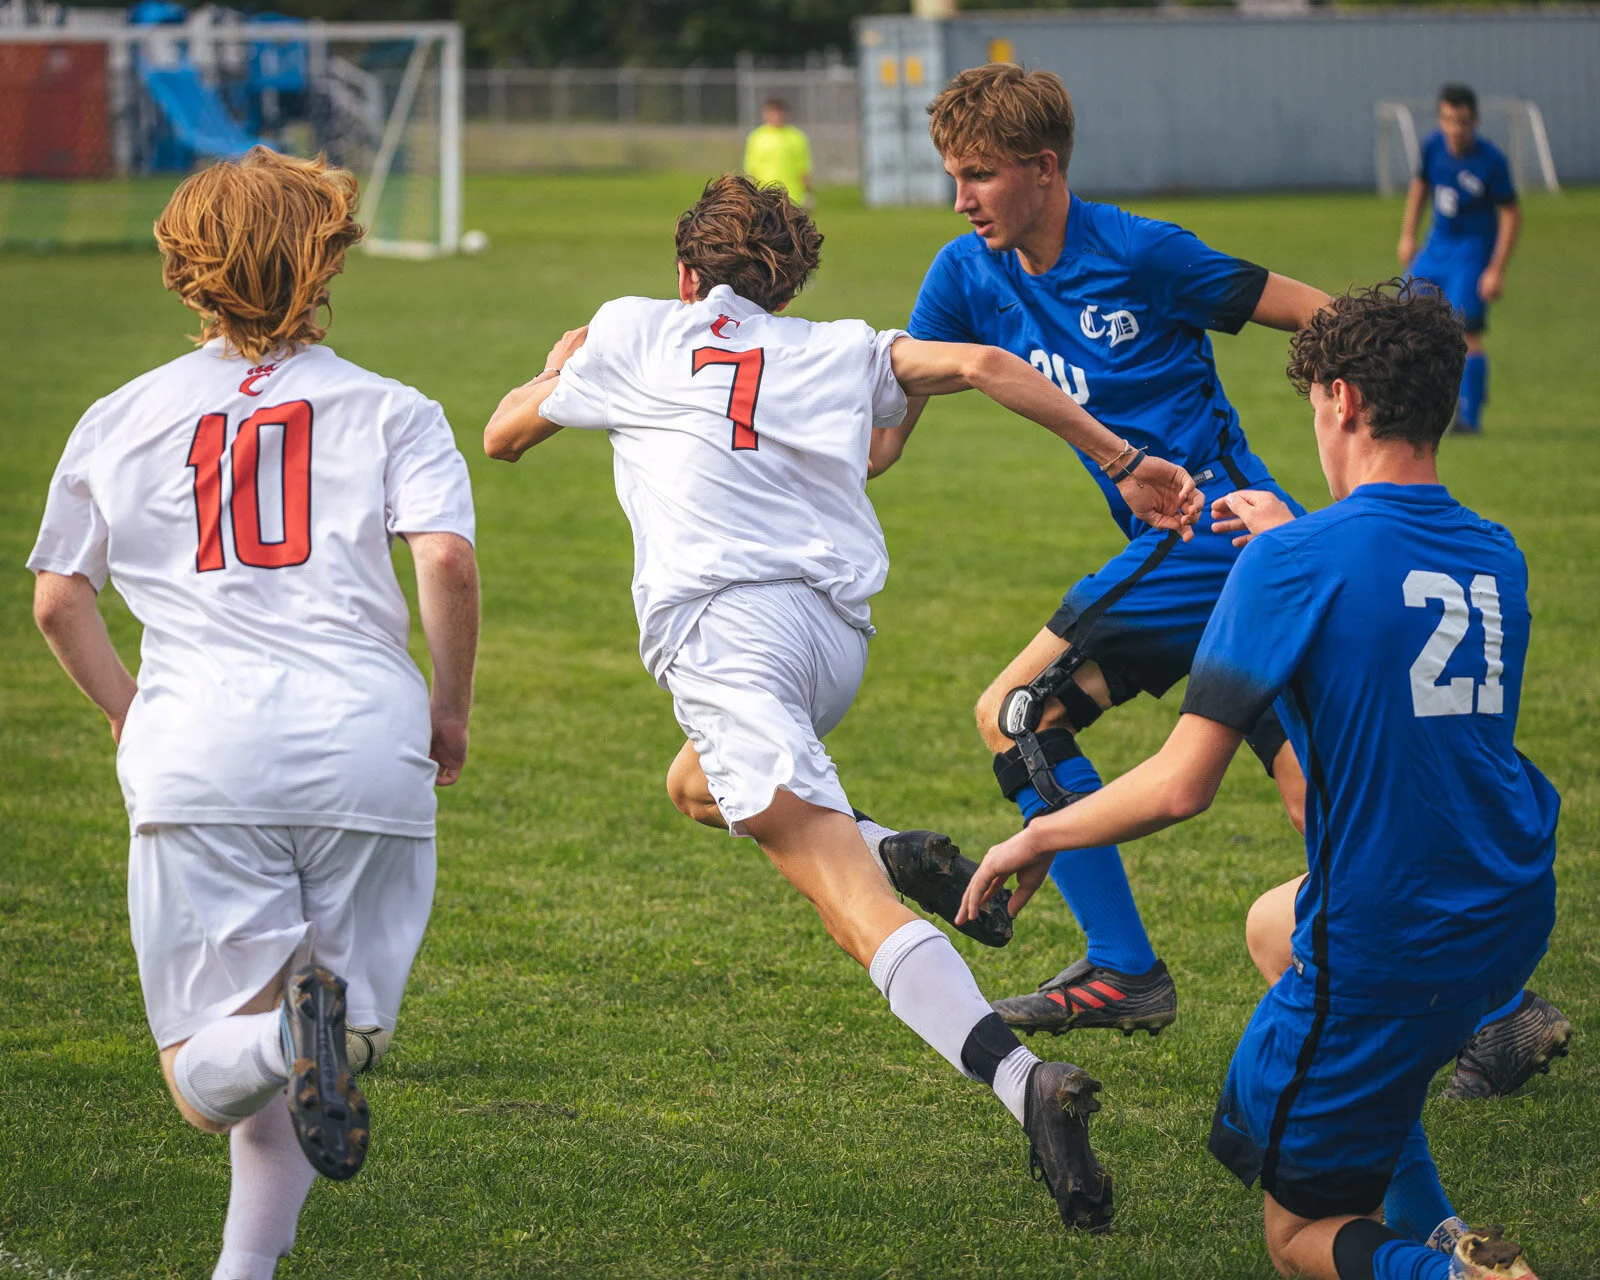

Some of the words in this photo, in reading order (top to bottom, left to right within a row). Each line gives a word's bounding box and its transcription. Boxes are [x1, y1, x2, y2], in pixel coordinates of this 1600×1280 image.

[692, 346, 765, 451] 7
[185, 399, 314, 573] 10
[1402, 570, 1504, 717] 21
